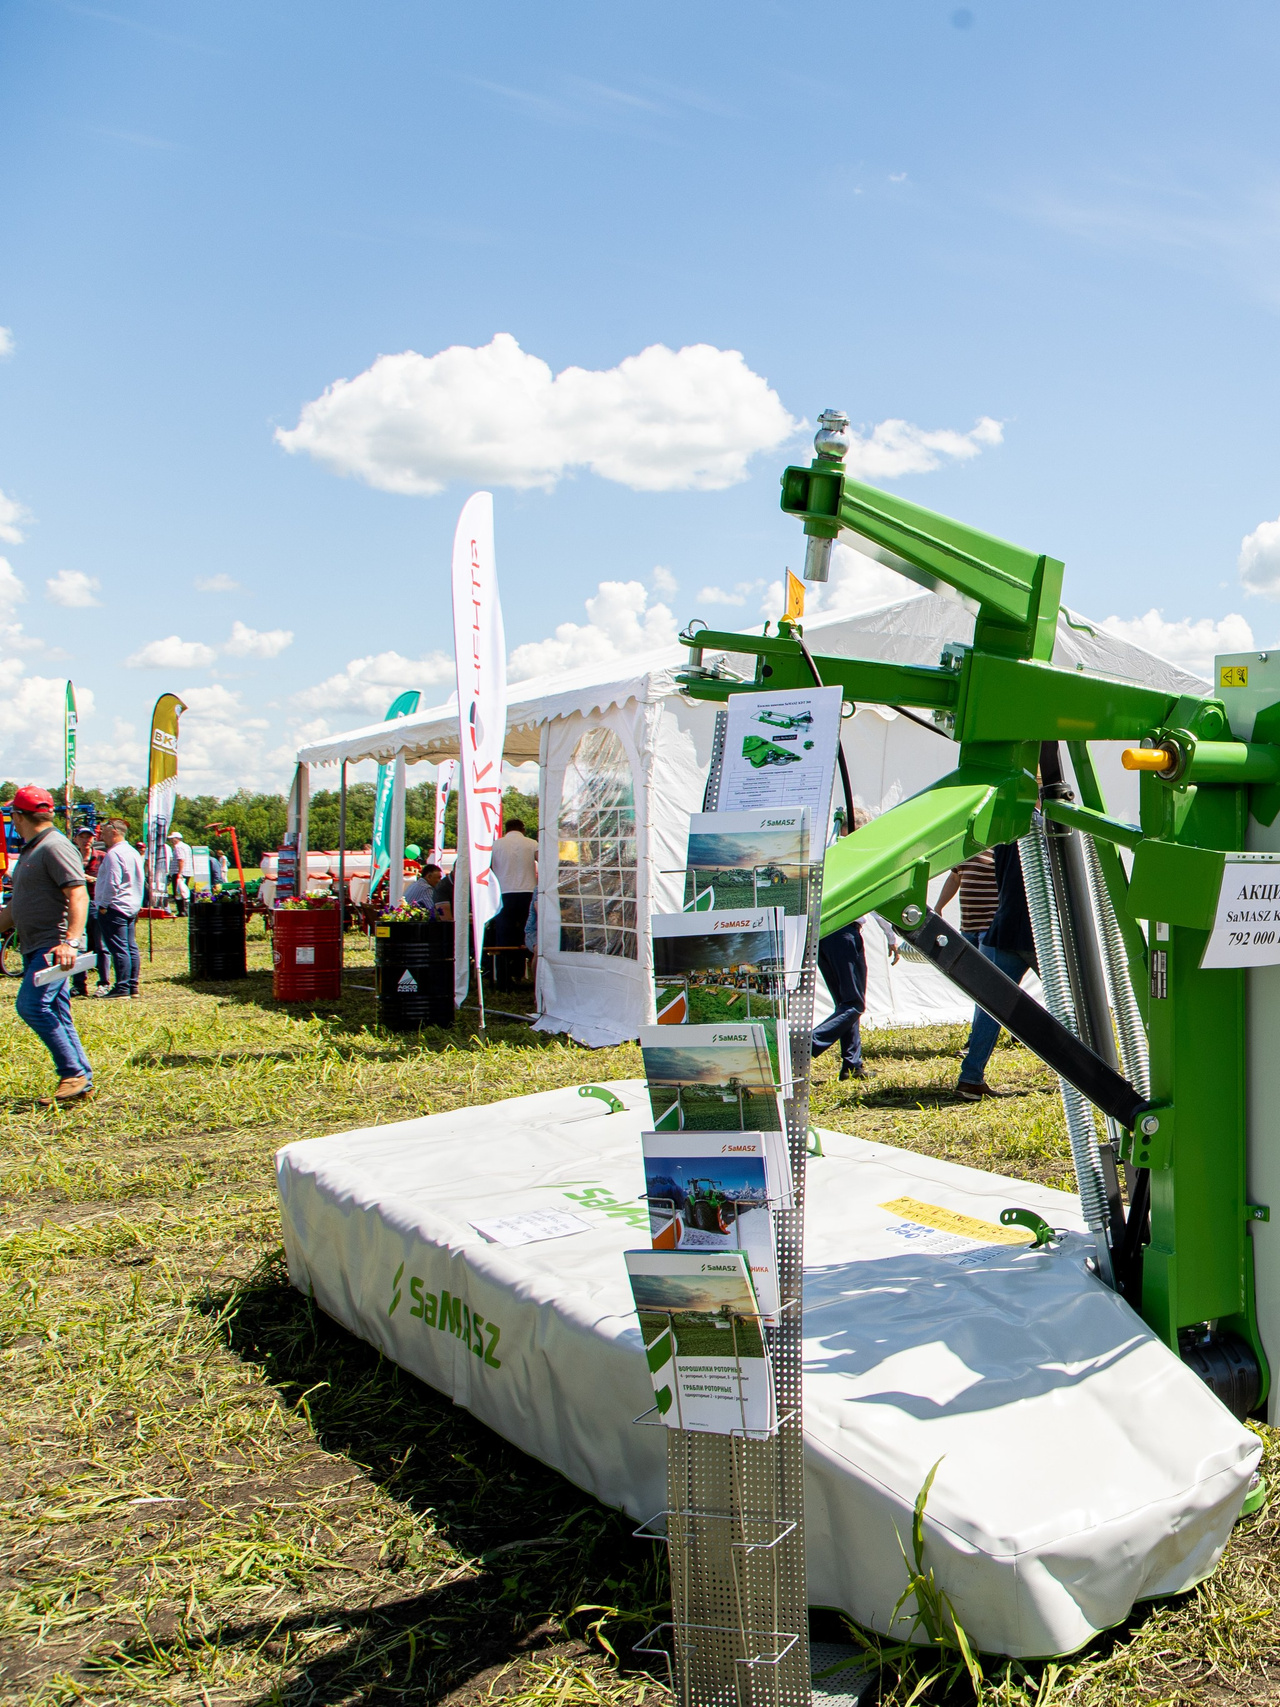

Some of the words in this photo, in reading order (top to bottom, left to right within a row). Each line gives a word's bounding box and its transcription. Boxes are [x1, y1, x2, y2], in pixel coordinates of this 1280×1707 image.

[154, 731, 177, 749] BK
[766, 818, 796, 827] SaMASZ
[1226, 909, 1271, 923] SaMASZ
[720, 920, 751, 929] SaMASZ
[1227, 931, 1250, 946] 792
[1252, 930, 1275, 945] 000
[718, 1034, 748, 1042] SaMASZ
[727, 1144, 757, 1152] SaMASZ
[707, 1263, 737, 1272] SaMASZ
[410, 1275, 501, 1370] SaMASZ
